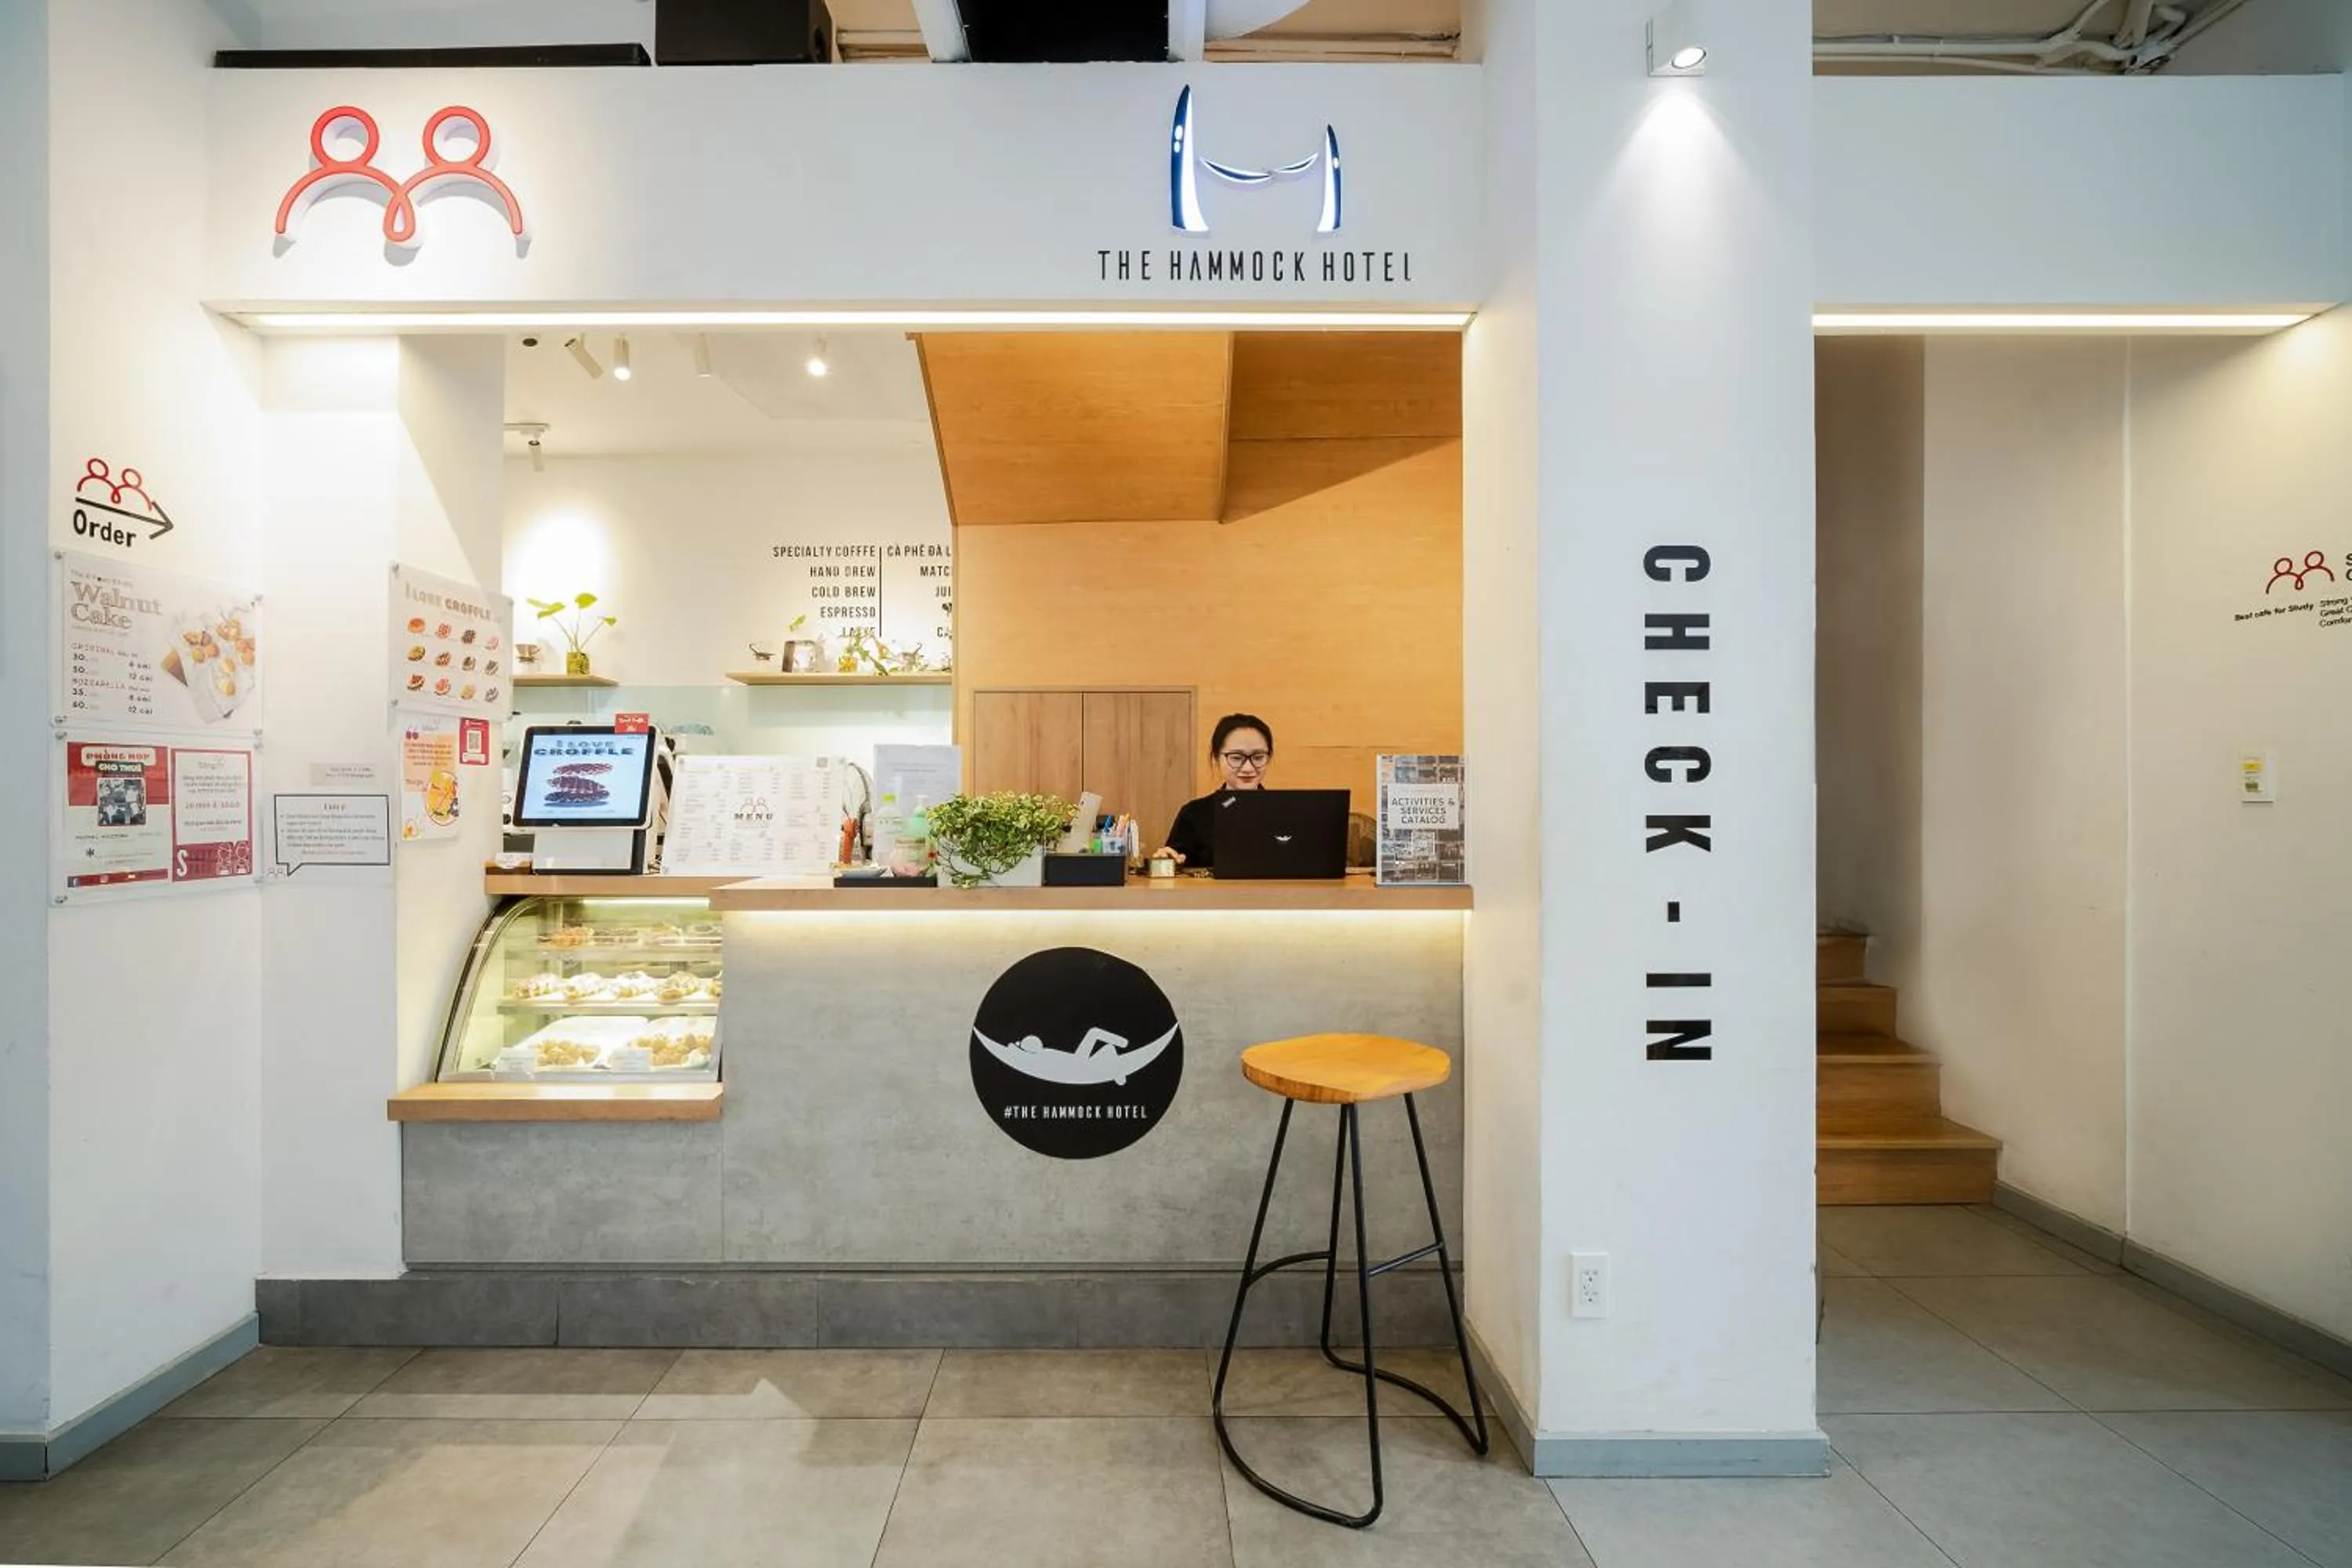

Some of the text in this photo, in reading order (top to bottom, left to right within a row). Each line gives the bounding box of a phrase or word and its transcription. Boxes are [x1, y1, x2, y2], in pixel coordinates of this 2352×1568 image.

[1098, 250, 1412, 281] THE HAMMOCK HOTEL
[73, 509, 136, 547] Order
[772, 546, 832, 557] SPECIALTY
[810, 566, 840, 577] HAND
[71, 581, 162, 615] Walnut
[811, 586, 876, 597] COLD BREW
[71, 603, 132, 630] Cake
[820, 606, 876, 618] ESPRESSO
[1392, 797, 1445, 806] ACTIVITIES
[1642, 545, 1712, 1061] CHECK-IN
[1004, 1105, 1147, 1119] #THE HAMMOCK HOTEL
